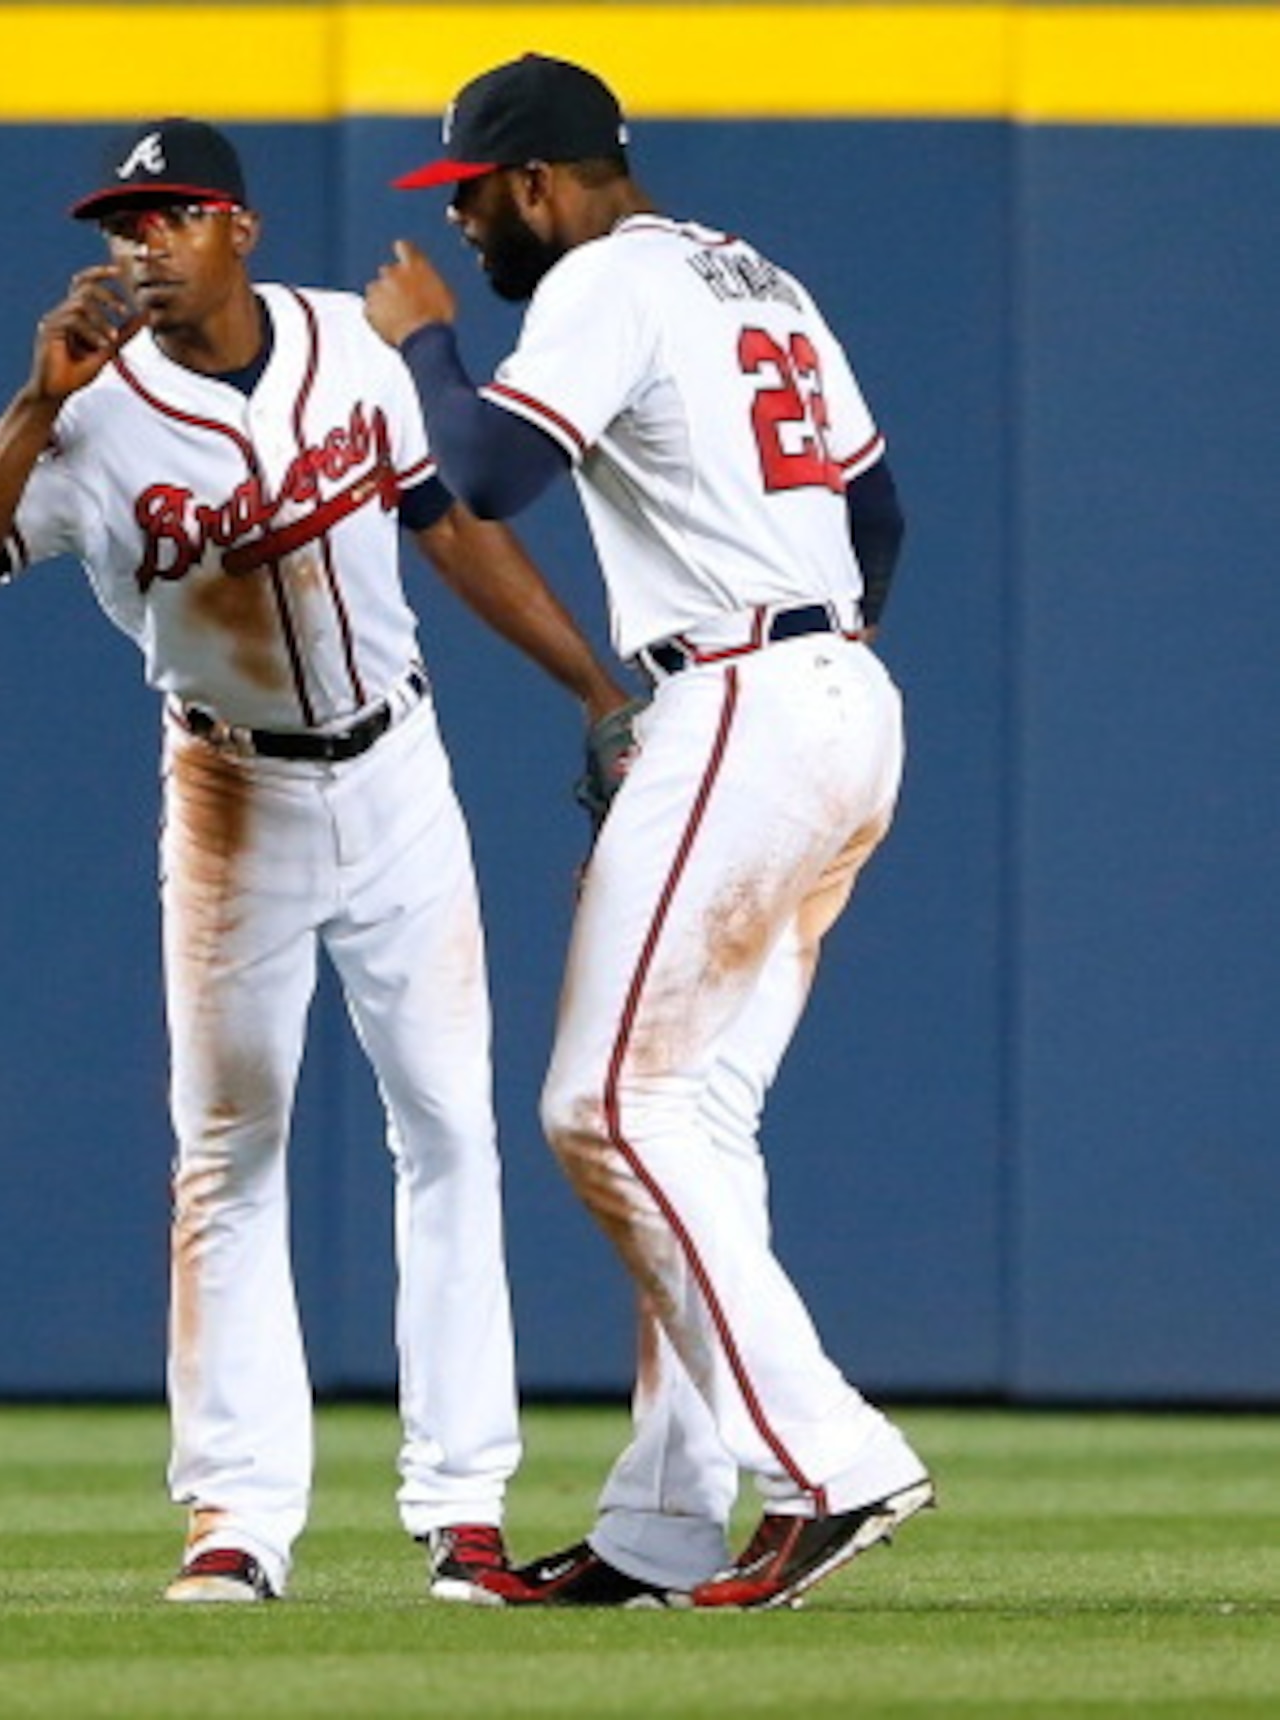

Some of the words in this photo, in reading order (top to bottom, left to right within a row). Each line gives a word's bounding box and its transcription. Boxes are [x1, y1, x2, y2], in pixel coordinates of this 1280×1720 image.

[115, 131, 166, 179] A
[738, 325, 847, 494] 22
[135, 400, 388, 594] Braves
